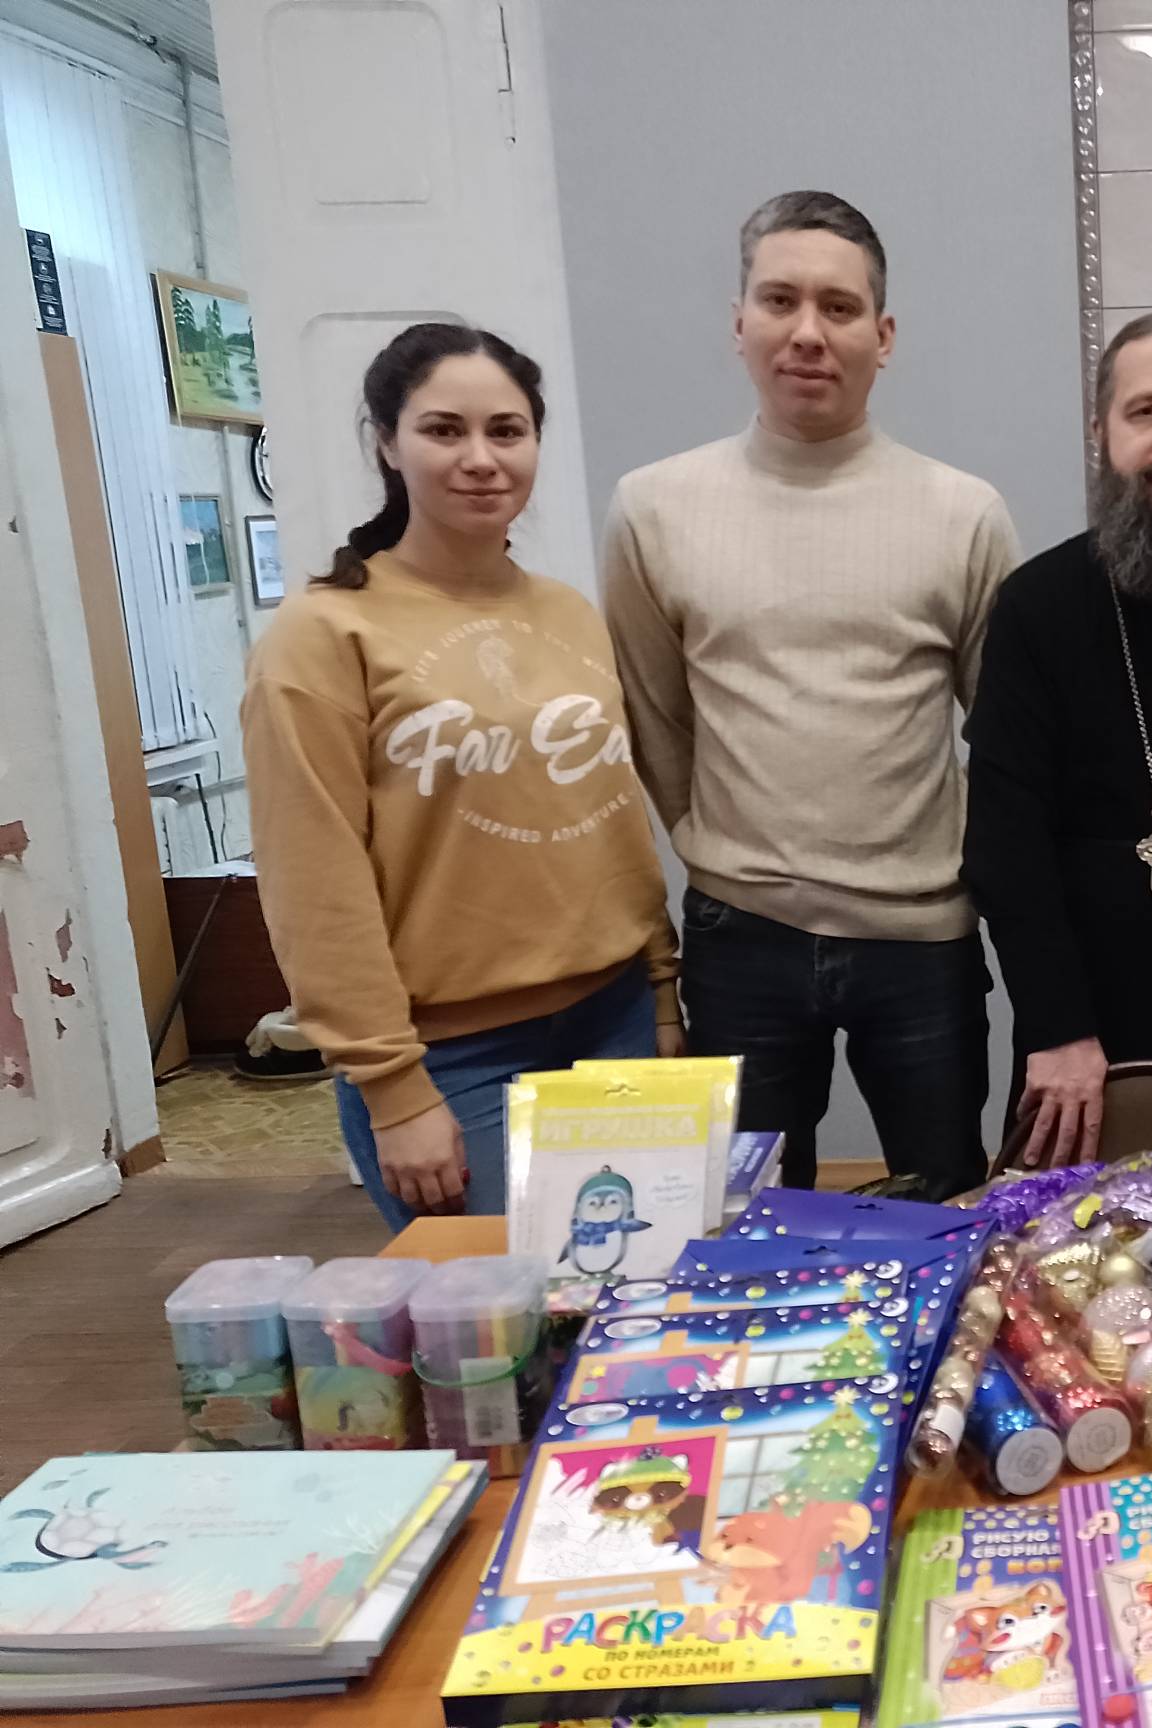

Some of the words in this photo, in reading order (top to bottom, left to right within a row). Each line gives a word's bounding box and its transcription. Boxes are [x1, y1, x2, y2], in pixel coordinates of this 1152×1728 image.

[386, 699, 521, 796] Far
[540, 1605, 797, 1654] РАСКРАСКА
[583, 1667, 611, 1681] СО
[619, 1660, 735, 1680] СТРАЗАМИ
[605, 1650, 629, 1662] ПО
[634, 1646, 720, 1660] НОМЕРАМ
